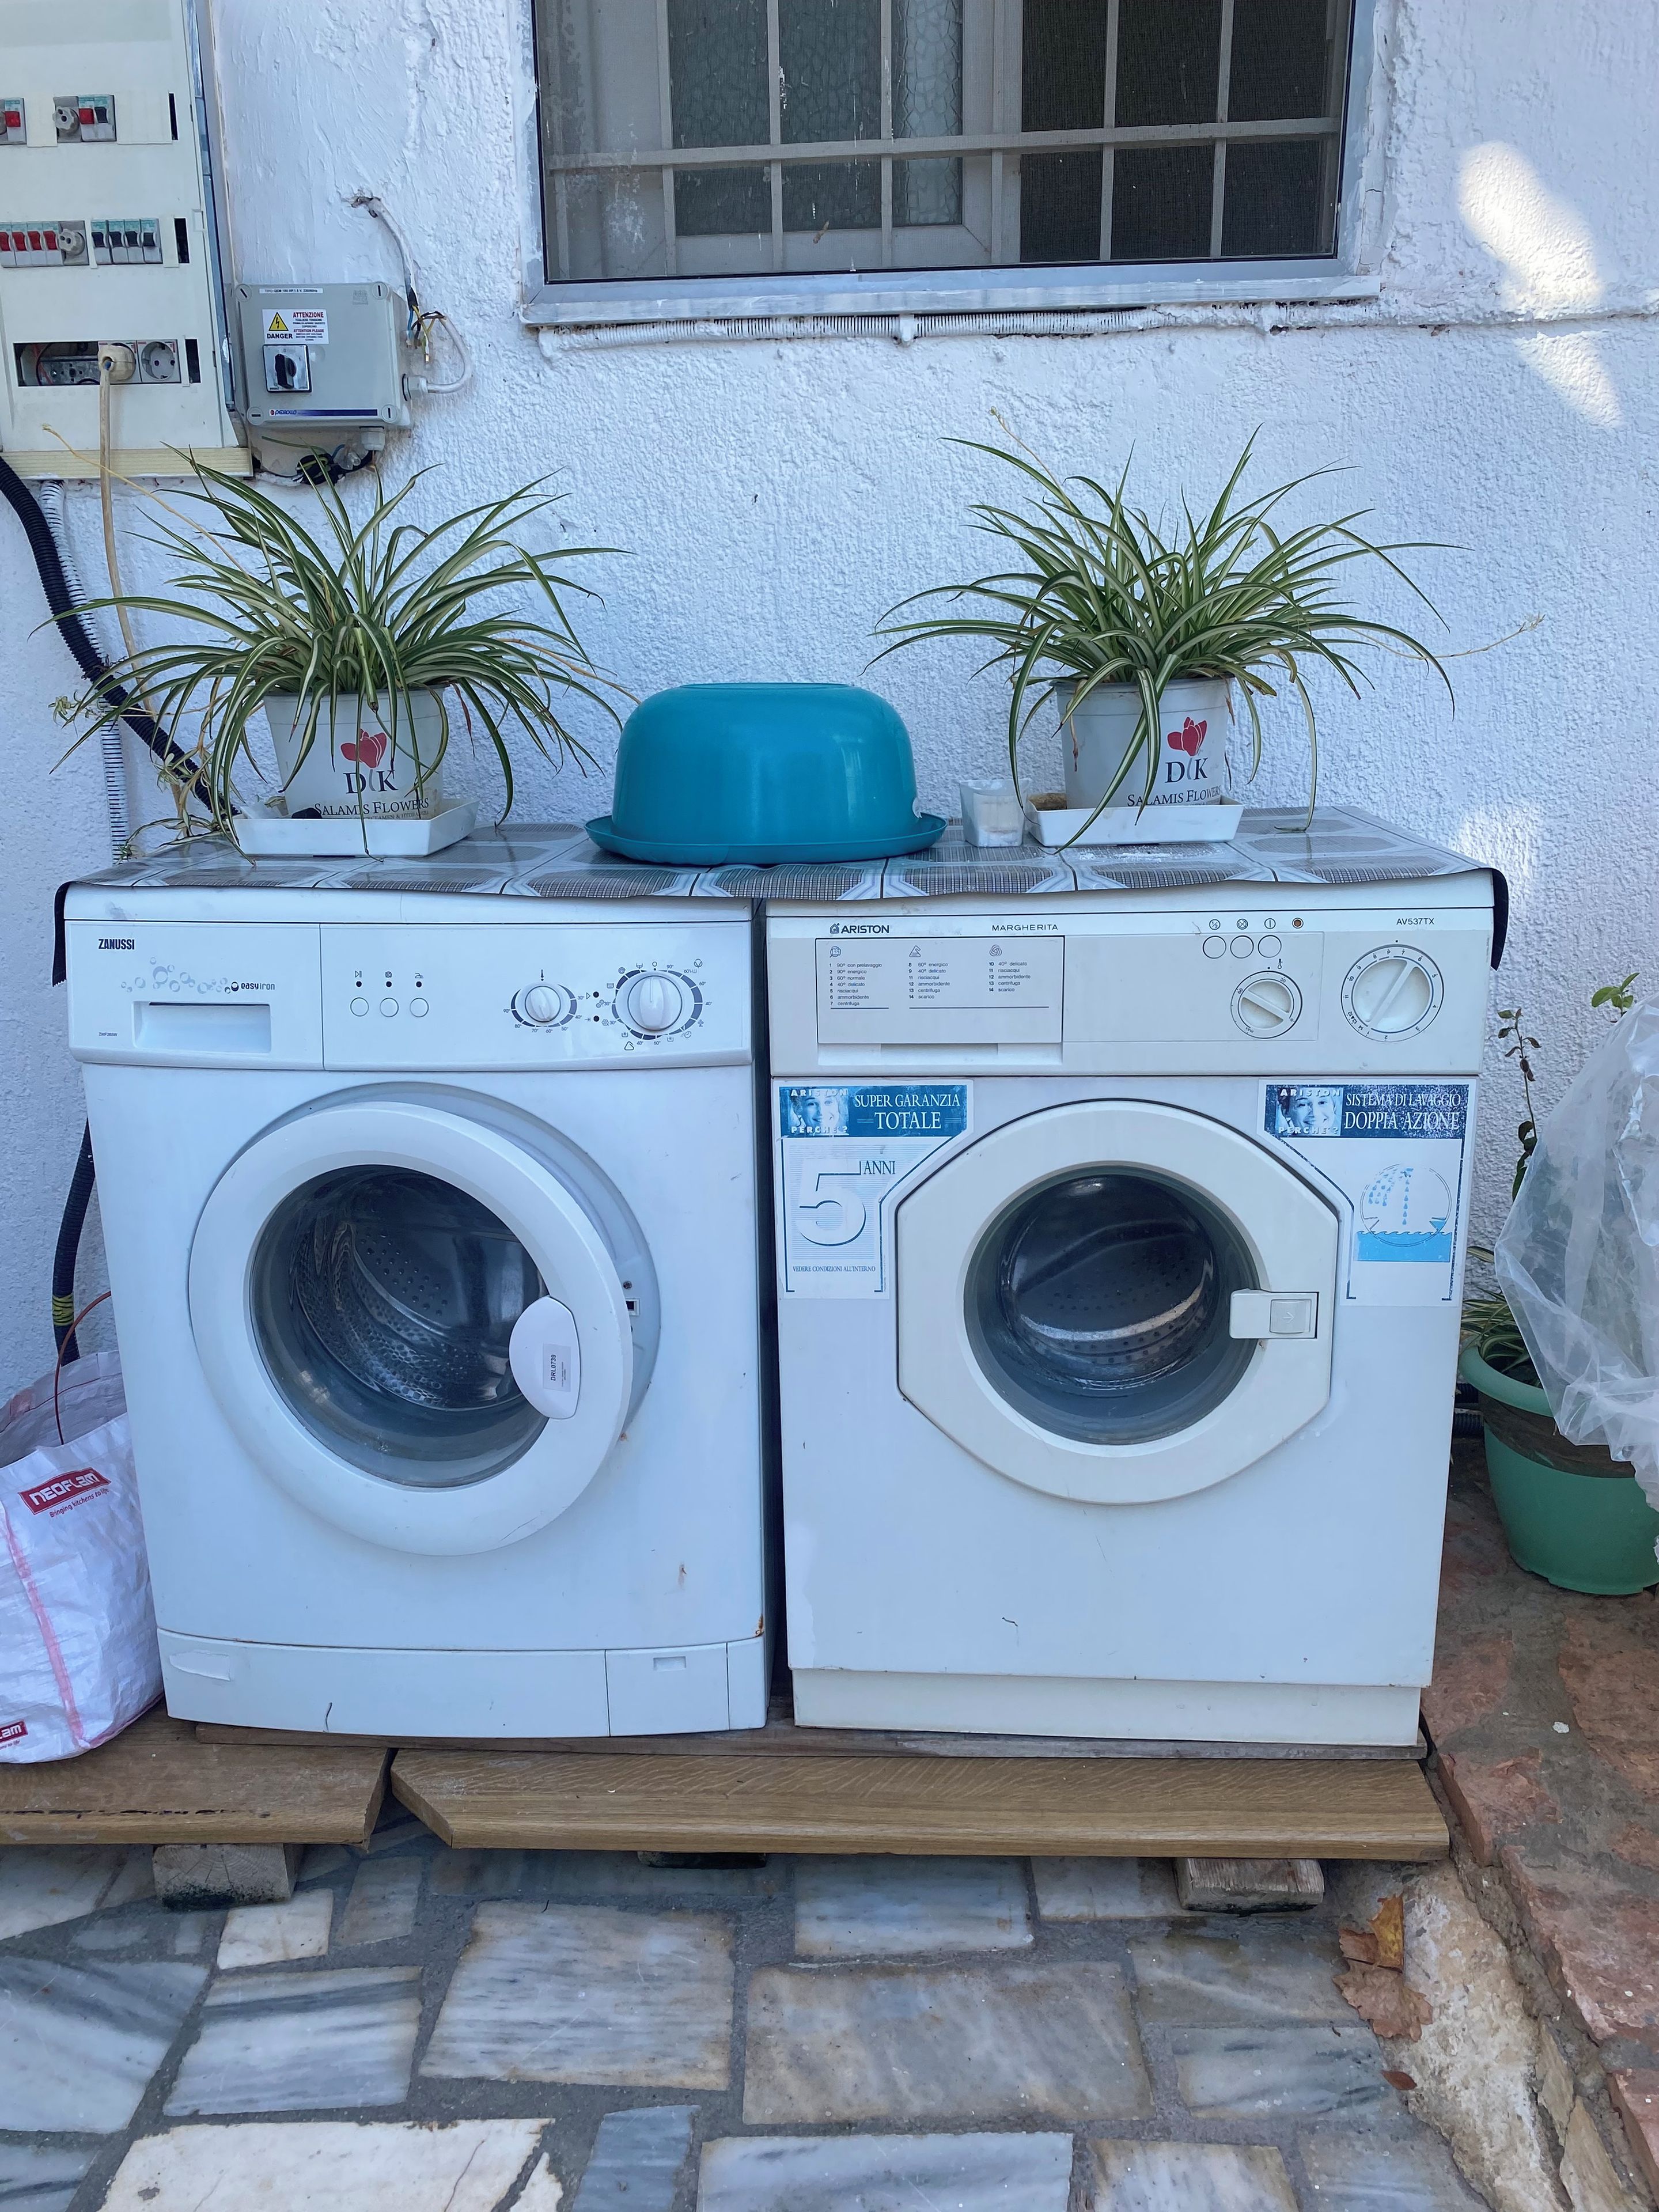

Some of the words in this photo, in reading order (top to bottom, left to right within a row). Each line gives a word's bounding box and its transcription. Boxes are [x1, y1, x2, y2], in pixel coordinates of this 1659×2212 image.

[315, 803, 369, 815] SALAMS
[373, 798, 429, 813] FLOWERS
[841, 925, 889, 934] ARISTON
[99, 938, 135, 950] ZANUSSI
[855, 1095, 892, 1108] SUPER
[895, 1094, 960, 1107] GARANZIA
[1346, 1093, 1393, 1107] SISTEMA
[1395, 1094, 1407, 1106] DI
[1408, 1093, 1461, 1107] LAVAGGIO
[874, 1112, 941, 1130] TOTALE
[1344, 1112, 1398, 1130] DOPPIA
[1403, 1112, 1461, 1130] AZIONE
[864, 1161, 896, 1175] ANNI
[49, 1504, 73, 1518] Bringing
[71, 1494, 94, 1507] kitchens
